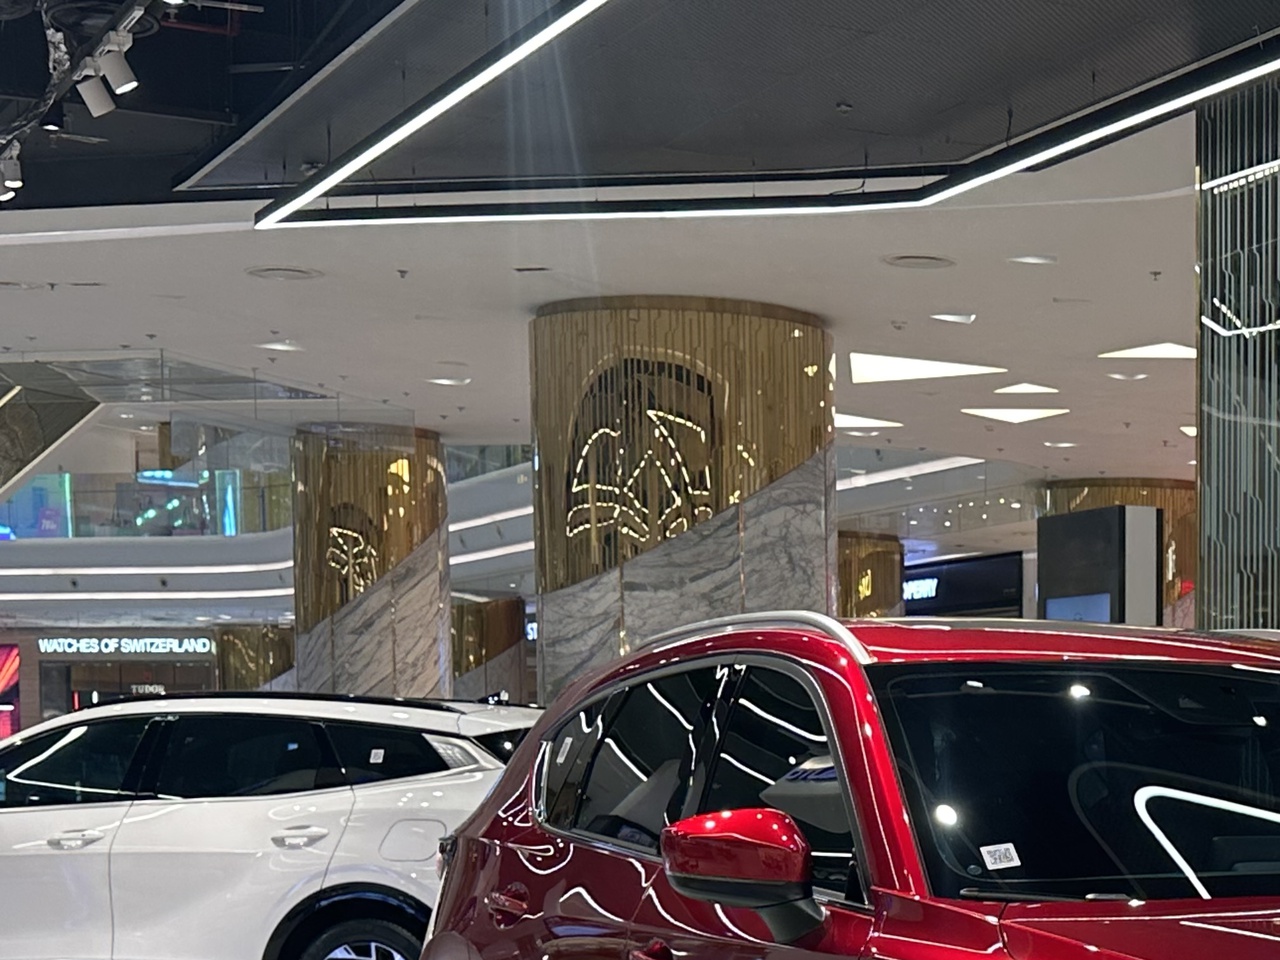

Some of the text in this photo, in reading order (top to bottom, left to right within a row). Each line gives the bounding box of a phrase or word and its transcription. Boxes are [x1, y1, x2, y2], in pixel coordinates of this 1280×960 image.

[38, 637, 211, 654] WATCHES OF SWITZERLAND
[130, 684, 166, 694] TUDOR
